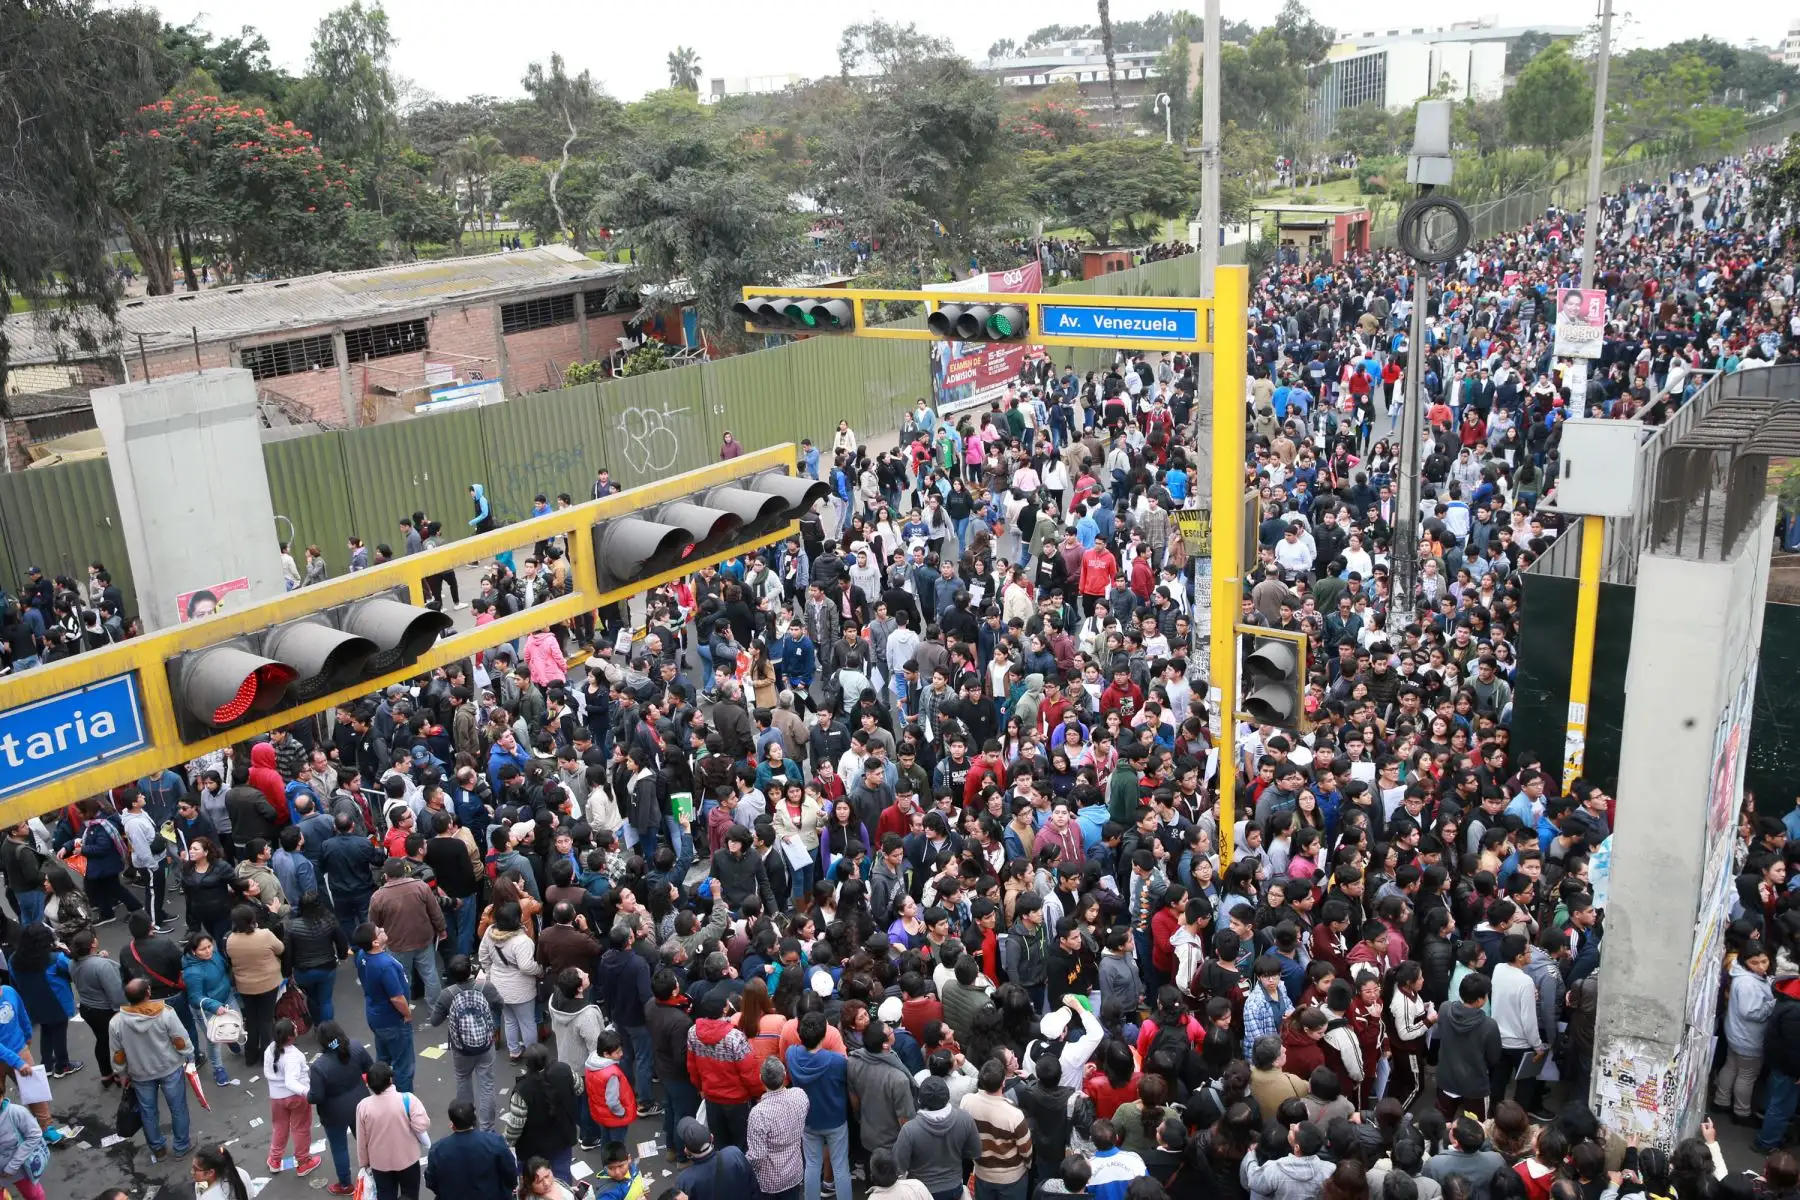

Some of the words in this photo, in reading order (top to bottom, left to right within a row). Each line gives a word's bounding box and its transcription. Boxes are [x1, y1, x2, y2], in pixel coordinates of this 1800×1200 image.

[1059, 314, 1081, 328] Av.
[1093, 314, 1178, 332] Venezuela
[972, 357, 982, 367] DE
[946, 368, 977, 385] ADMISIÓN
